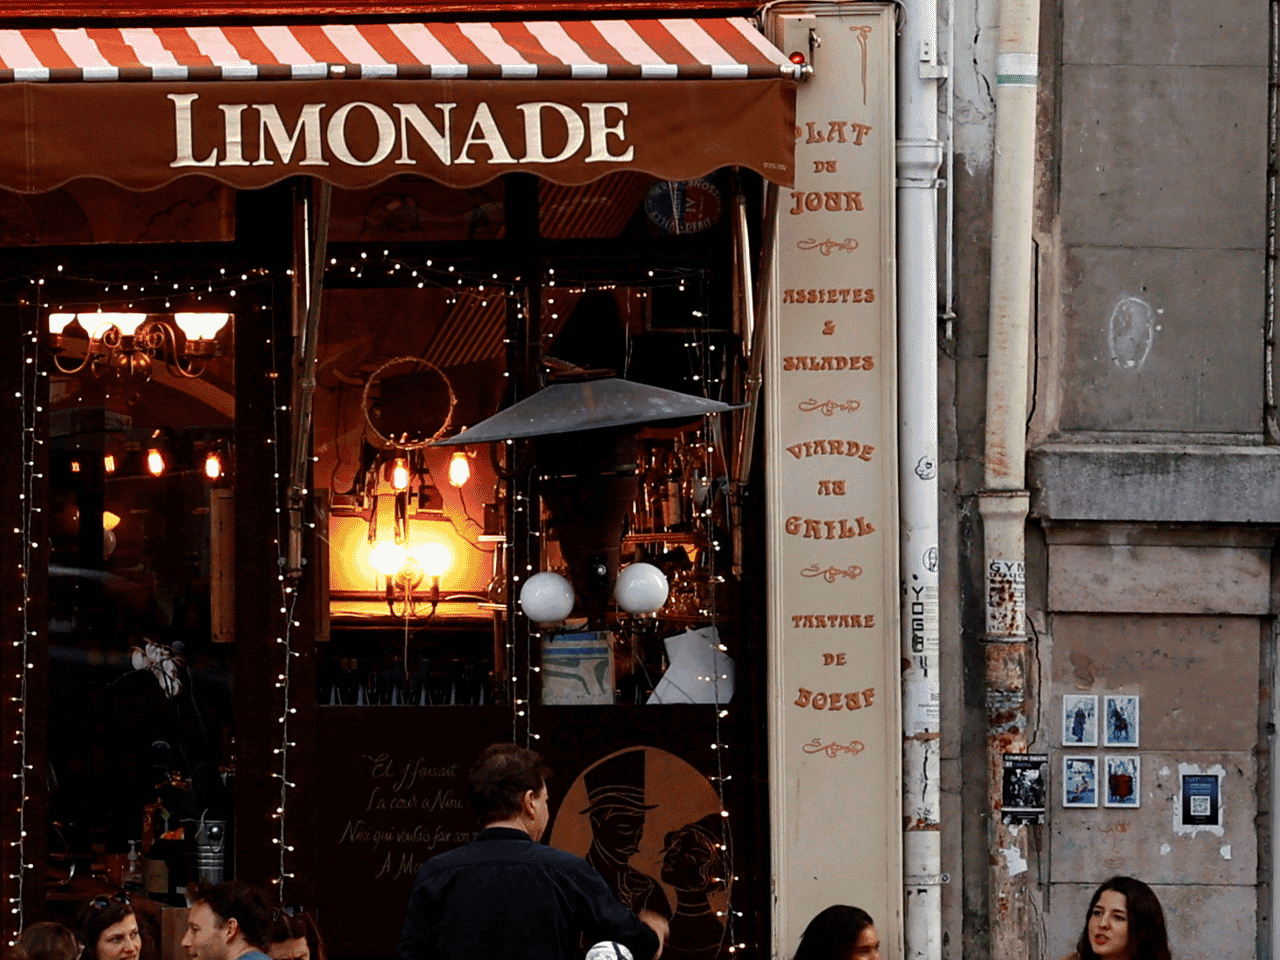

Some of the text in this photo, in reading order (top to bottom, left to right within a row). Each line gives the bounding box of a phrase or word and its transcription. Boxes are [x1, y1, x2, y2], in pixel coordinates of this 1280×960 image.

[166, 93, 636, 168] LIMONADE
[813, 160, 837, 173] DU
[790, 191, 864, 215] JOUR
[822, 320, 835, 335] &
[783, 355, 875, 371] SALADES
[817, 480, 847, 496] AU
[785, 515, 876, 540] GRILL
[792, 614, 876, 628] TARTARE
[822, 653, 847, 666] DE
[794, 687, 876, 711] BOEUF
[430, 789, 463, 812] Nini
[373, 827, 394, 851] qui
